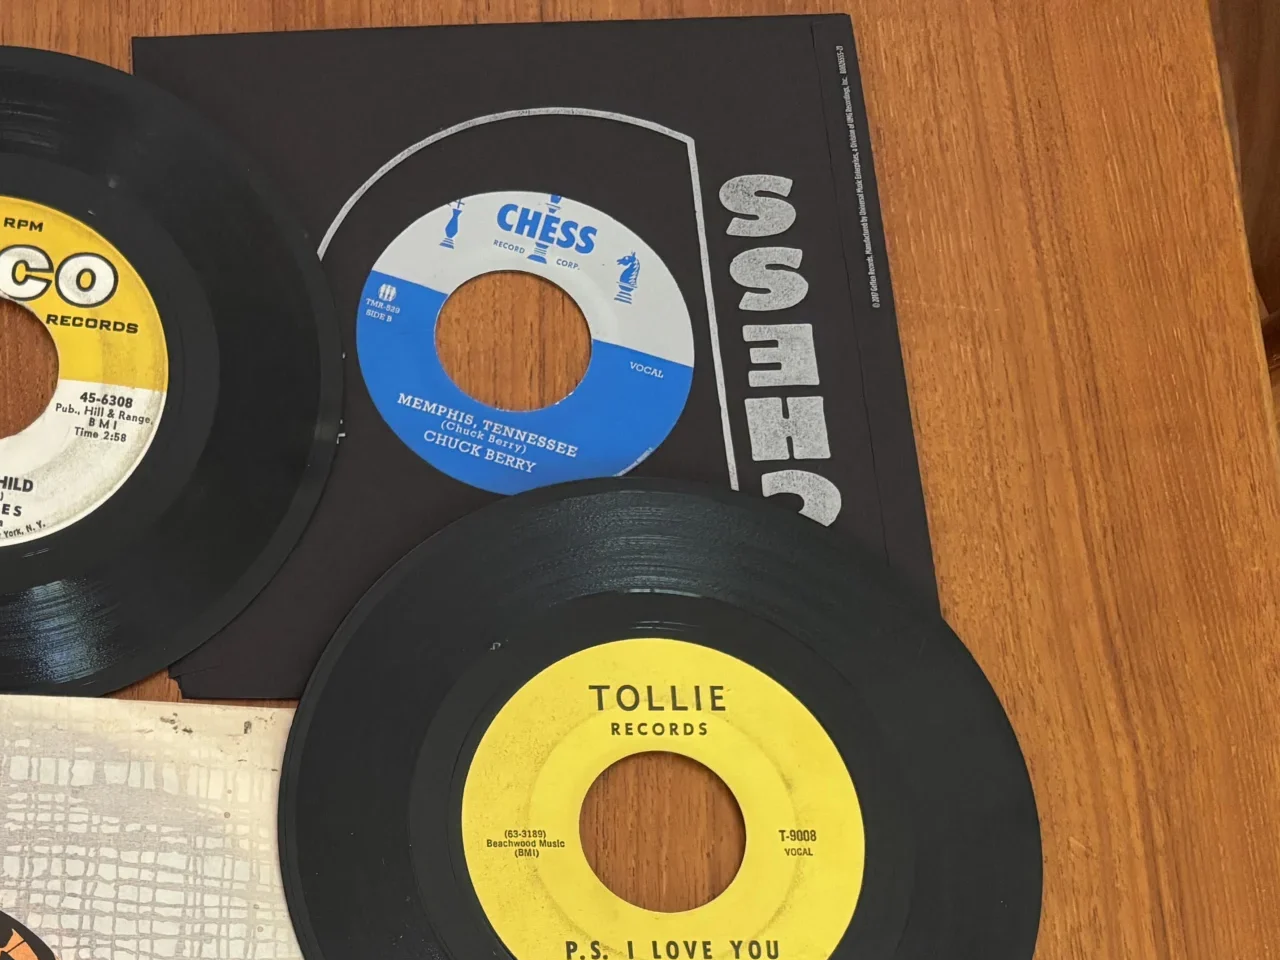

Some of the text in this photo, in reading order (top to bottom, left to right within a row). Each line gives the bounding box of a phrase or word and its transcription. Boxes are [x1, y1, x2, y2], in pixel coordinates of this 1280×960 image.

[4, 217, 43, 232] RPM
[496, 203, 597, 254] CHESS
[493, 239, 580, 271] RECORD CORP.
[365, 309, 383, 321] SIDE
[46, 314, 138, 334] RECORDS
[629, 361, 664, 378] VOCAL
[80, 392, 133, 408] 45-6308
[84, 406, 115, 418] Hill &
[398, 393, 578, 458] MEMPHIS, TENNESSEE
[75, 427, 127, 442] Time 2:58
[440, 419, 527, 454] (Chuck Berry)
[423, 430, 537, 473] CHUCK BERRY
[589, 684, 727, 711] TOLLIE
[611, 722, 708, 736] RECORDS
[504, 830, 546, 839] (63-3189)
[779, 830, 817, 842] T-9008
[486, 839, 565, 849] Beachwood Music
[514, 848, 540, 858] (BMI)
[785, 848, 813, 857] VOCAL
[566, 940, 780, 960] P.S. I LOVE YOU
